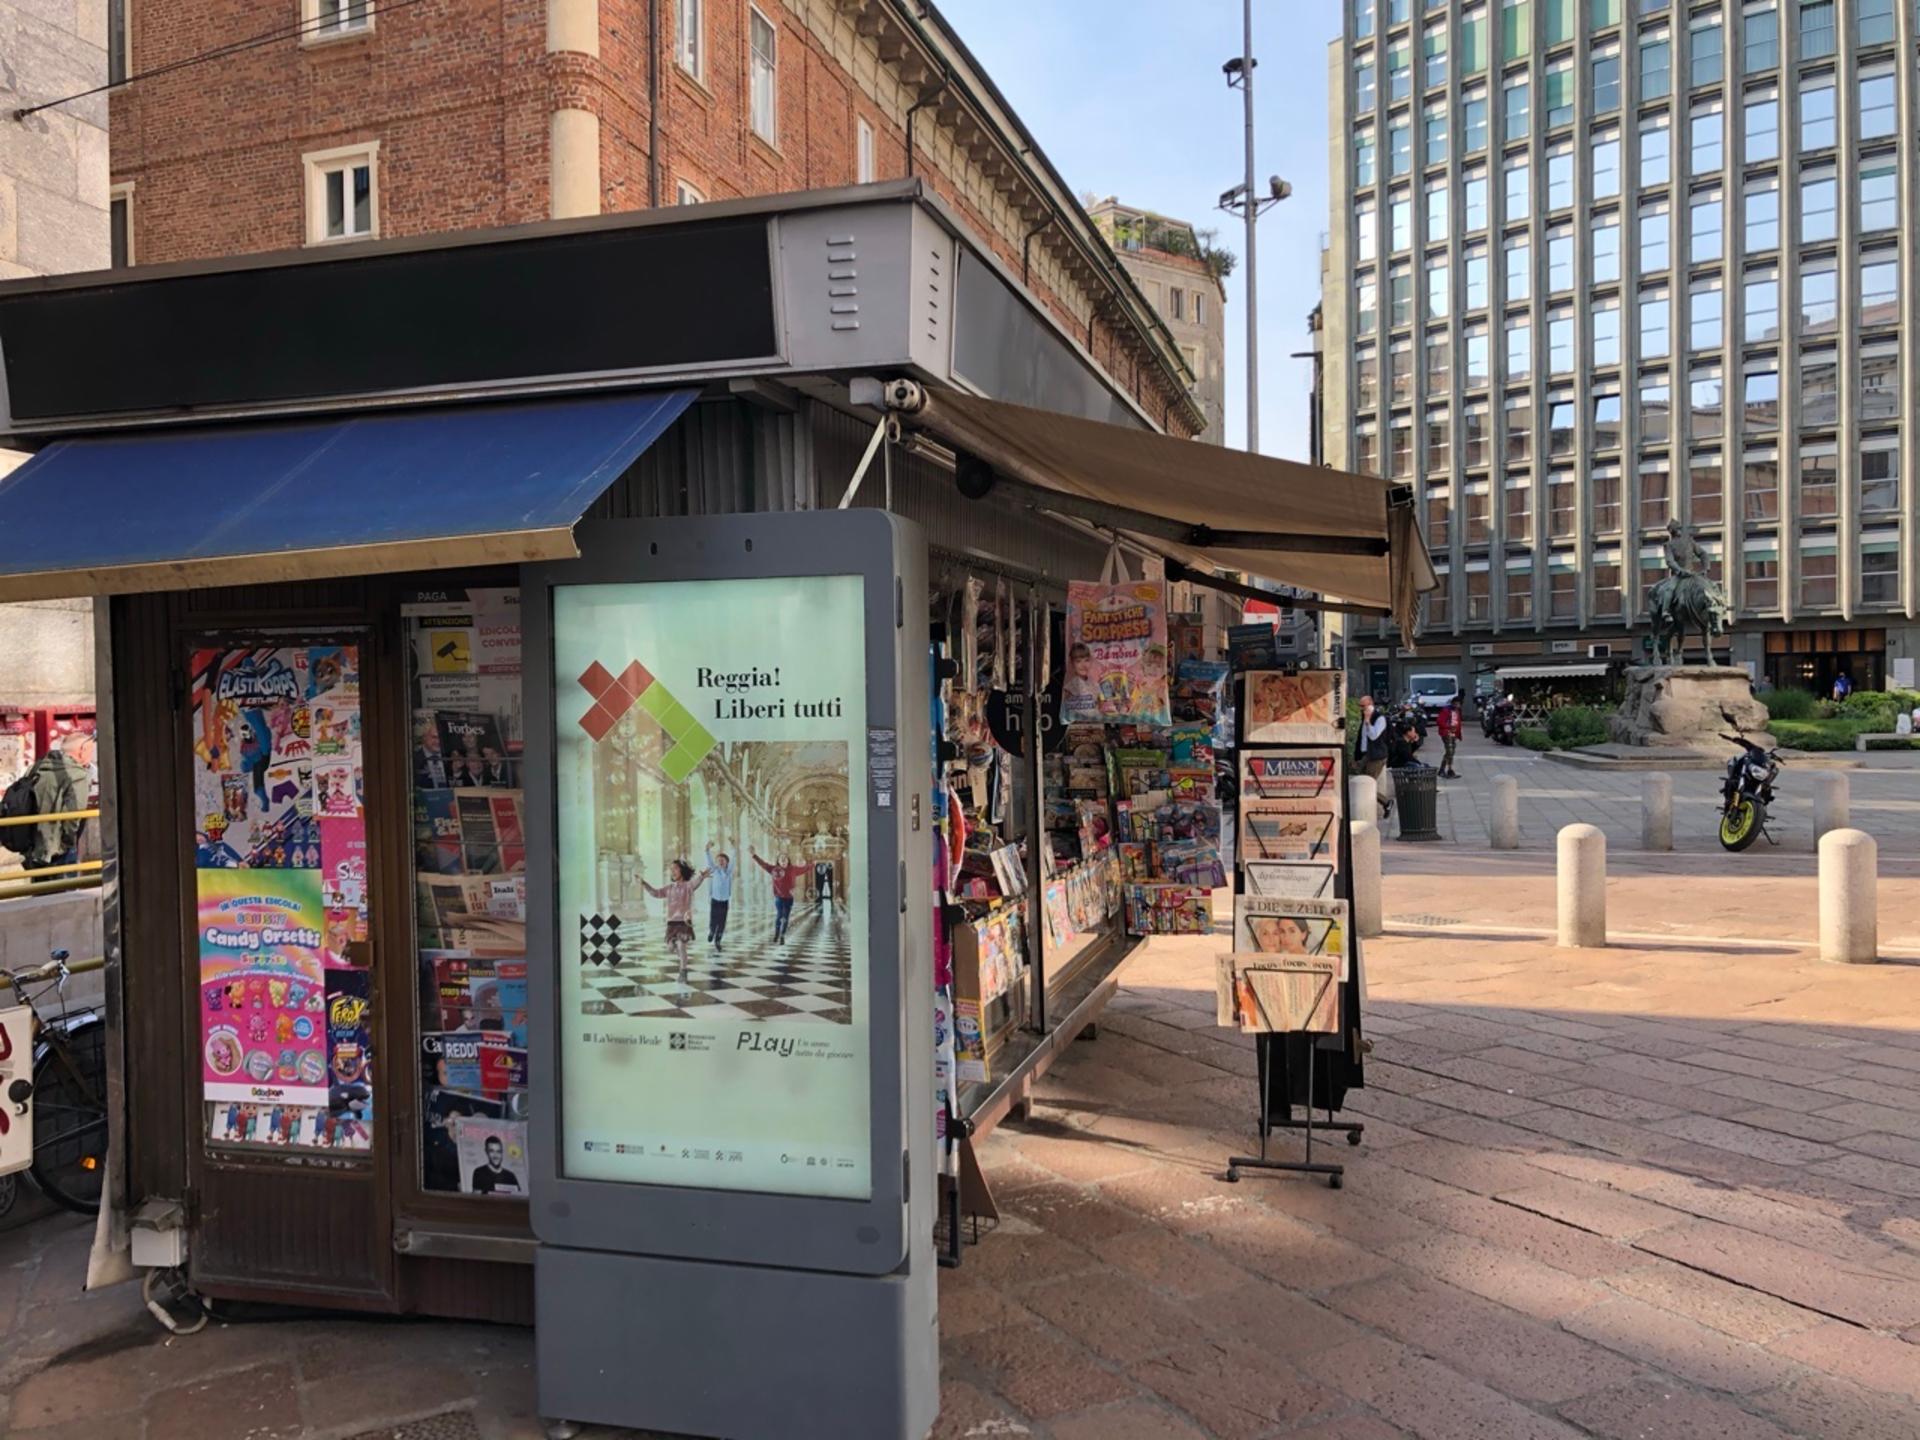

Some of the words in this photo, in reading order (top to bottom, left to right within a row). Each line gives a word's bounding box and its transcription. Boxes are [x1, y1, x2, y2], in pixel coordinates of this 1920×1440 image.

[417, 592, 447, 602] PAGA
[1082, 620, 1150, 641] SORPRESE
[697, 667, 780, 693] Reggia!
[714, 697, 785, 719] Liberi
[793, 697, 842, 718] tutti
[447, 721, 485, 736] Forbes
[1266, 760, 1316, 775] MILANO
[1258, 901, 1280, 913] DIE
[1296, 903, 1325, 915] ZEIT
[206, 928, 259, 951] Candy
[262, 928, 321, 948] Orsetti
[736, 1031, 795, 1057] Play
